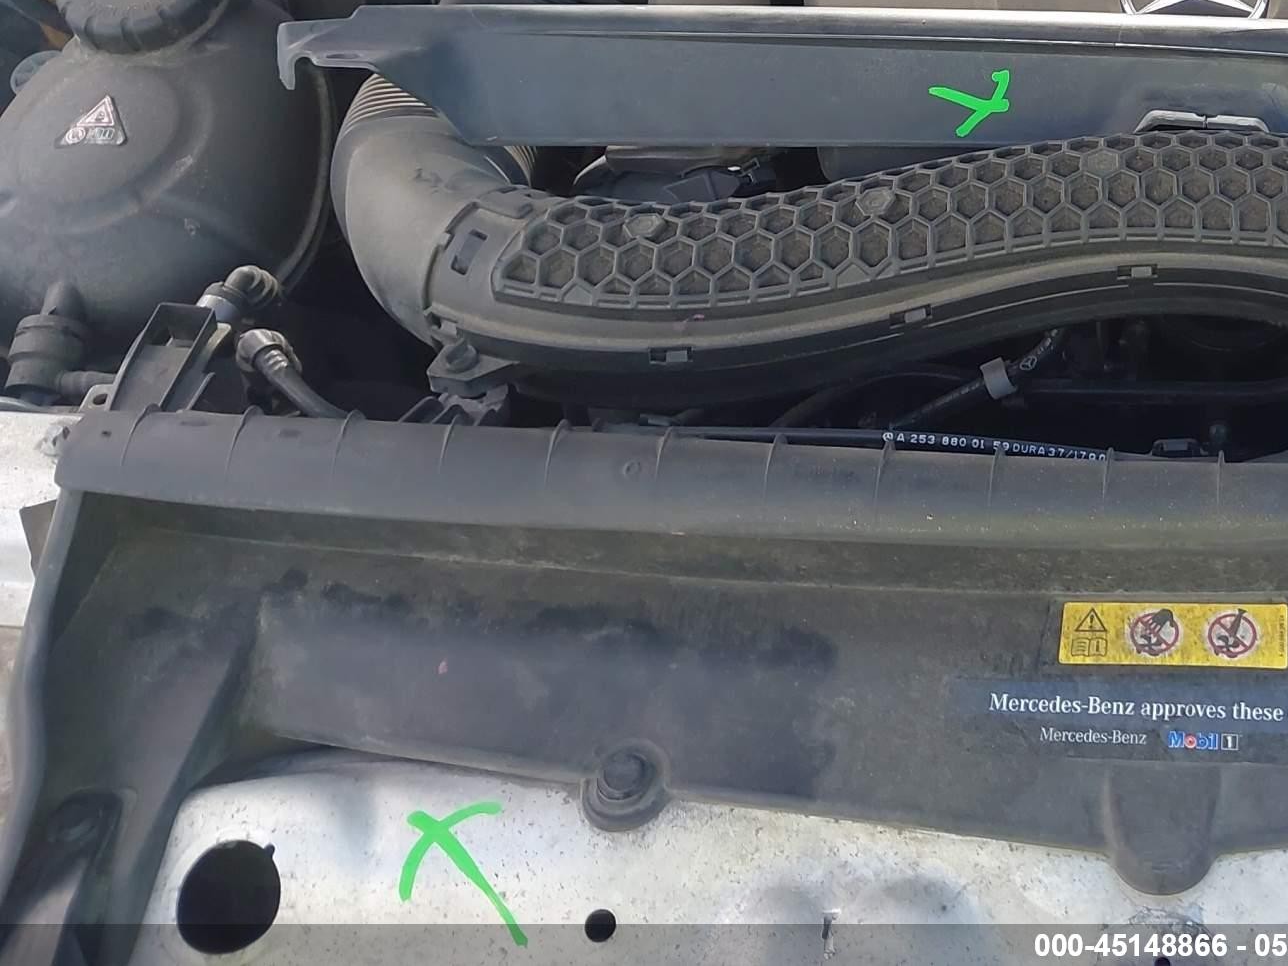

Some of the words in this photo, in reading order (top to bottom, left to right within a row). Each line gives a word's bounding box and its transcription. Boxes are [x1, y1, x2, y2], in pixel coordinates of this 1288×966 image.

[910, 434, 935, 444] 253
[942, 436, 967, 447] 880
[988, 692, 1135, 716] Mercedes-Benz
[1140, 702, 1227, 721] approves
[1232, 702, 1284, 722] these
[1039, 727, 1147, 745] Mercedes-Benz
[1168, 731, 1218, 750] Mobil
